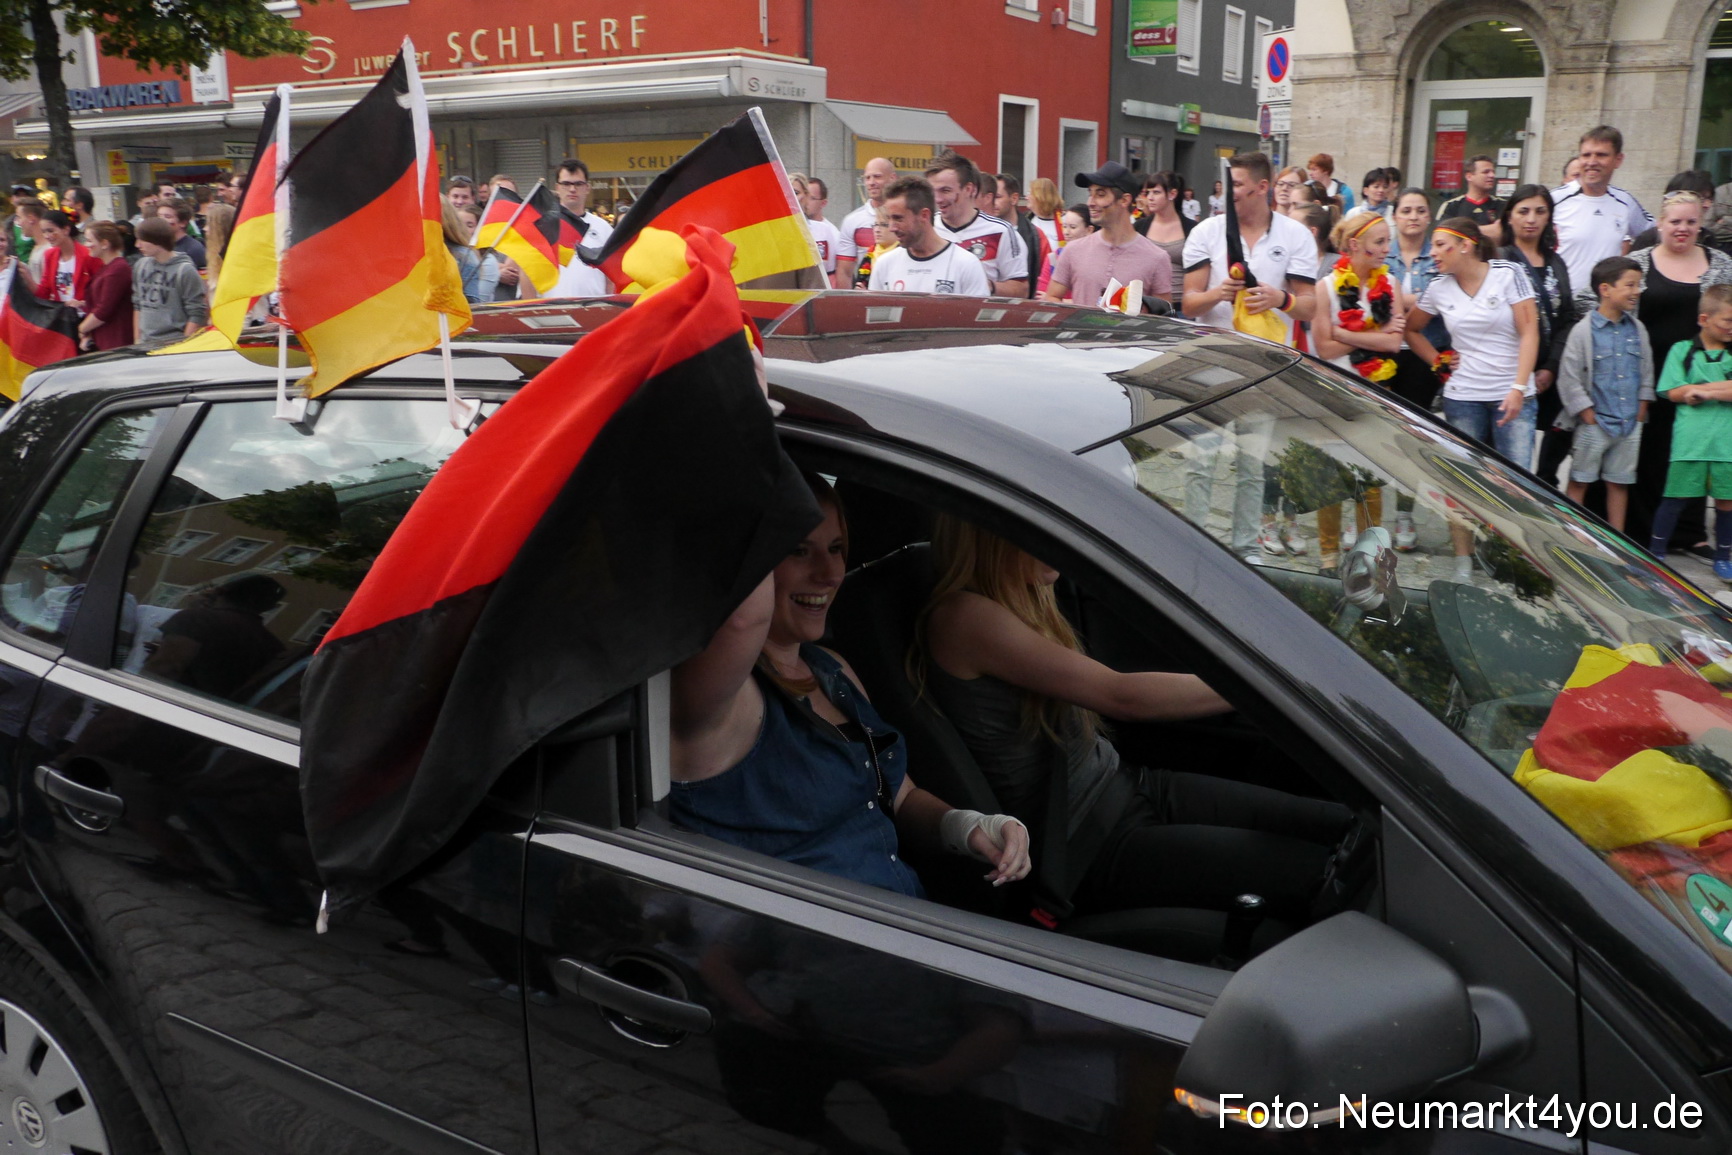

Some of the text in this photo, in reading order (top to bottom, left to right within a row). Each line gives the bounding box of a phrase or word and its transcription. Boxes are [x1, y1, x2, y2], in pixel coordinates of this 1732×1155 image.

[447, 14, 648, 63] SCHLIERF
[1133, 31, 1161, 40] dess
[66, 80, 182, 111] BAKWAREN
[764, 84, 806, 97] SCHLIERF
[1267, 85, 1286, 98] ZONE
[628, 154, 684, 168] SCHLI
